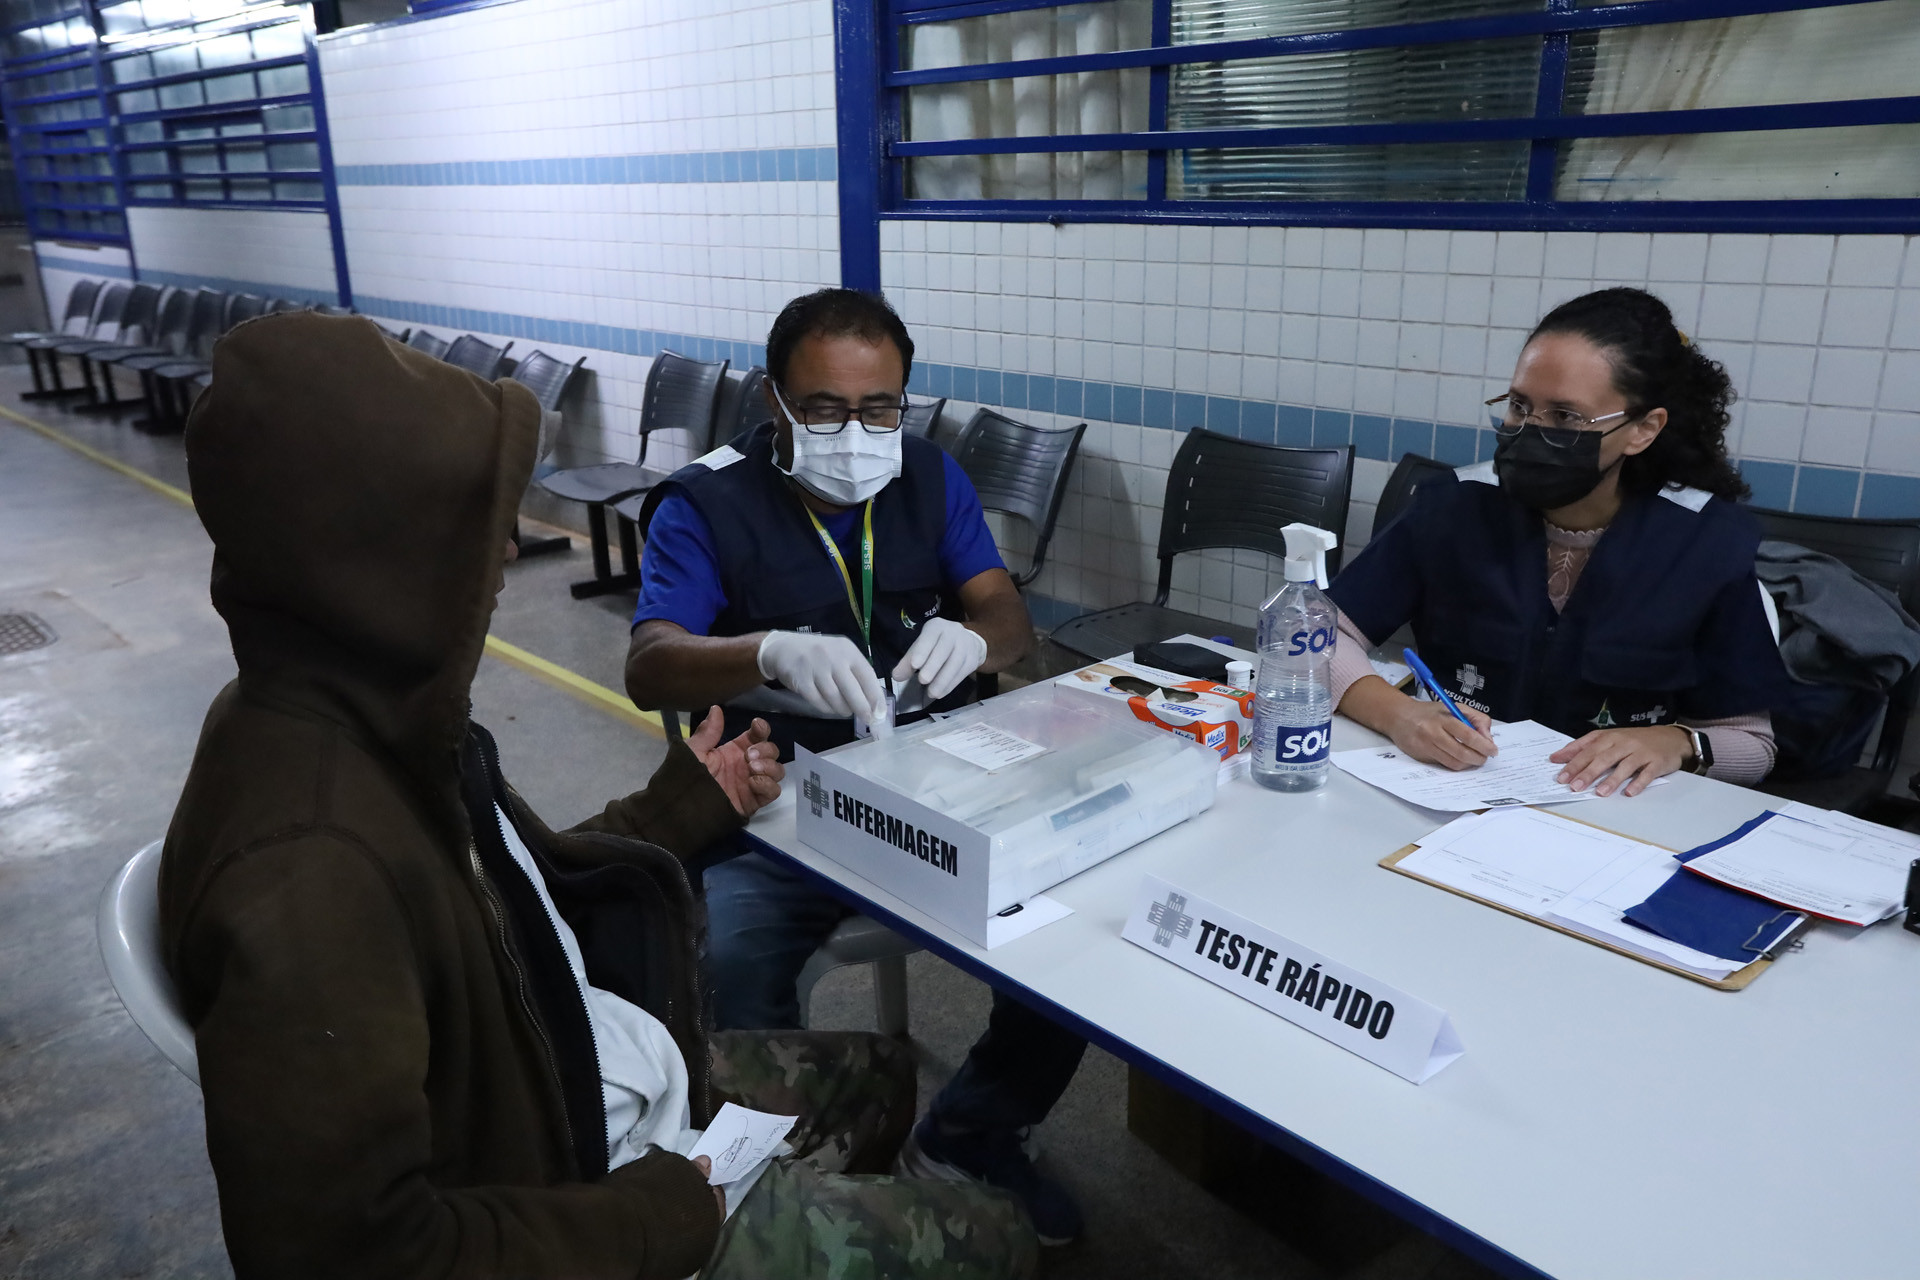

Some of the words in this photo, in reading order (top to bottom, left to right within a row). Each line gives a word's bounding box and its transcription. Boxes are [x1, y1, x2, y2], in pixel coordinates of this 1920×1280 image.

[863, 539, 873, 570] SES-DF
[1288, 626, 1336, 656] SOL
[1443, 688, 1490, 713] NSULTÓRIO
[1630, 712, 1647, 722] SUS
[1207, 731, 1225, 747] Medix
[1282, 728, 1330, 759] SOL
[833, 790, 958, 878] ENFERMAGEM
[1194, 919, 1278, 986] TESTE
[1275, 963, 1395, 1040] RÁPIDO
